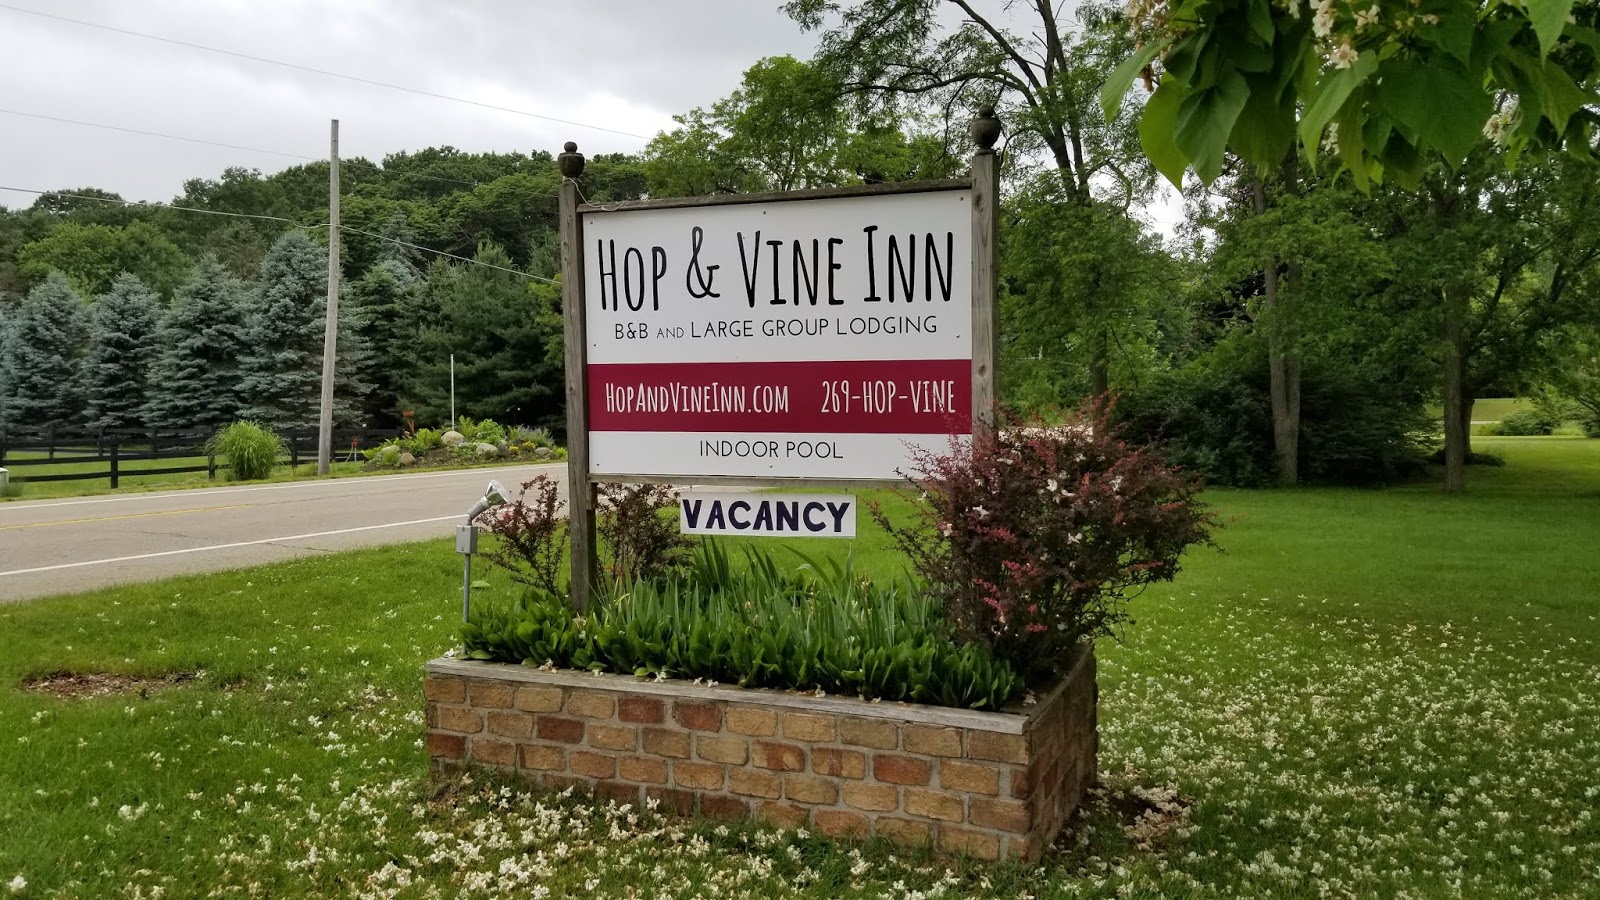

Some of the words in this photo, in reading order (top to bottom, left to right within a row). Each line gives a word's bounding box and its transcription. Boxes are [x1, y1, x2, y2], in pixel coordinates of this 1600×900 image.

[597, 238, 668, 312] HOP
[685, 225, 721, 299] &
[736, 230, 845, 309] VINE
[862, 224, 954, 304] INN
[615, 322, 649, 340] B&B
[656, 326, 685, 339] AND
[691, 320, 754, 338] LARGE
[761, 318, 829, 337] GROUP
[836, 315, 937, 335] LODGING
[821, 379, 956, 414] 269-HOP-VINE
[700, 440, 779, 458] INDOOR
[786, 441, 844, 459] POOL
[681, 498, 851, 534] VACANCY
